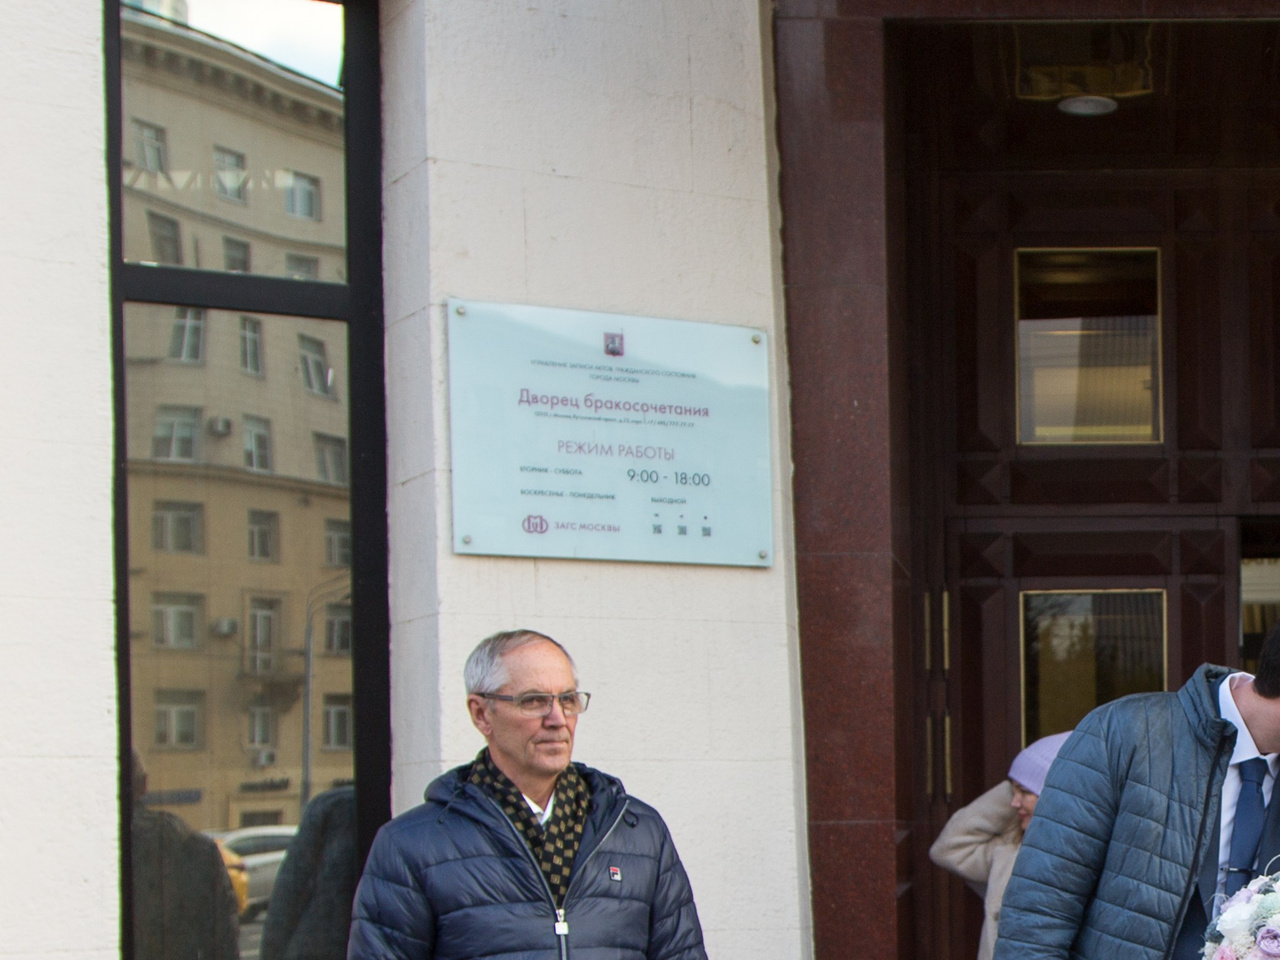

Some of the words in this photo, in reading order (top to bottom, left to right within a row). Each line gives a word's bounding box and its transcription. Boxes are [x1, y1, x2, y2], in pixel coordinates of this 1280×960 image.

[518, 388, 580, 409] Дворец
[583, 392, 710, 418] бракосочетания
[557, 440, 613, 456] РЕЖИМ
[618, 444, 675, 461] РАБОТЫ
[519, 466, 549, 474] ВТОРНИК
[554, 468, 583, 476] СУББОТА
[626, 468, 659, 484] 9:00
[674, 471, 711, 487] 18:00
[520, 489, 564, 498] ВОСКРЕСЕНЬЕ
[569, 491, 616, 500] ПОНЕДЕЛЬНИК
[651, 496, 687, 505] ВЫХОДНОЙ
[554, 521, 577, 531] ЗАГС
[579, 523, 620, 532] МОСКВЫ
